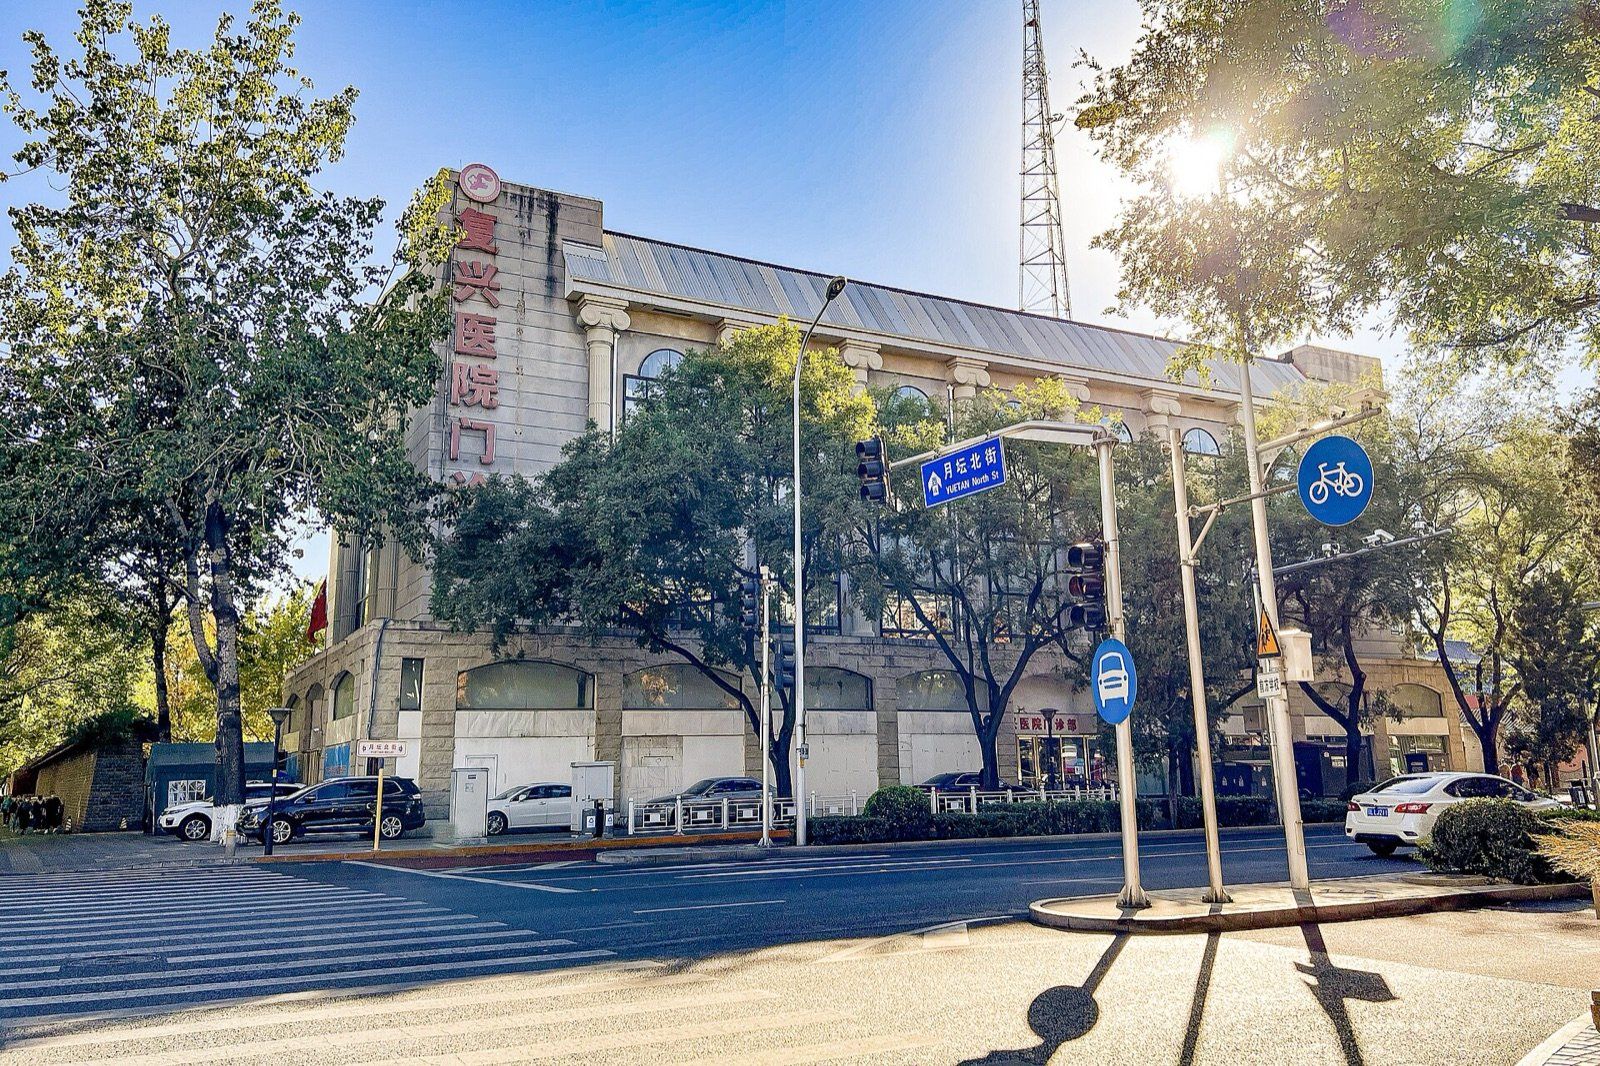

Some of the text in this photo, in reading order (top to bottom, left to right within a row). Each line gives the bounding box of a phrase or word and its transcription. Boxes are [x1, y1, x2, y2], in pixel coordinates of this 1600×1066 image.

[944, 446, 997, 480] 月坛北街
[946, 480, 970, 495] YUETAN
[972, 474, 989, 486] North
[991, 470, 999, 480] St
